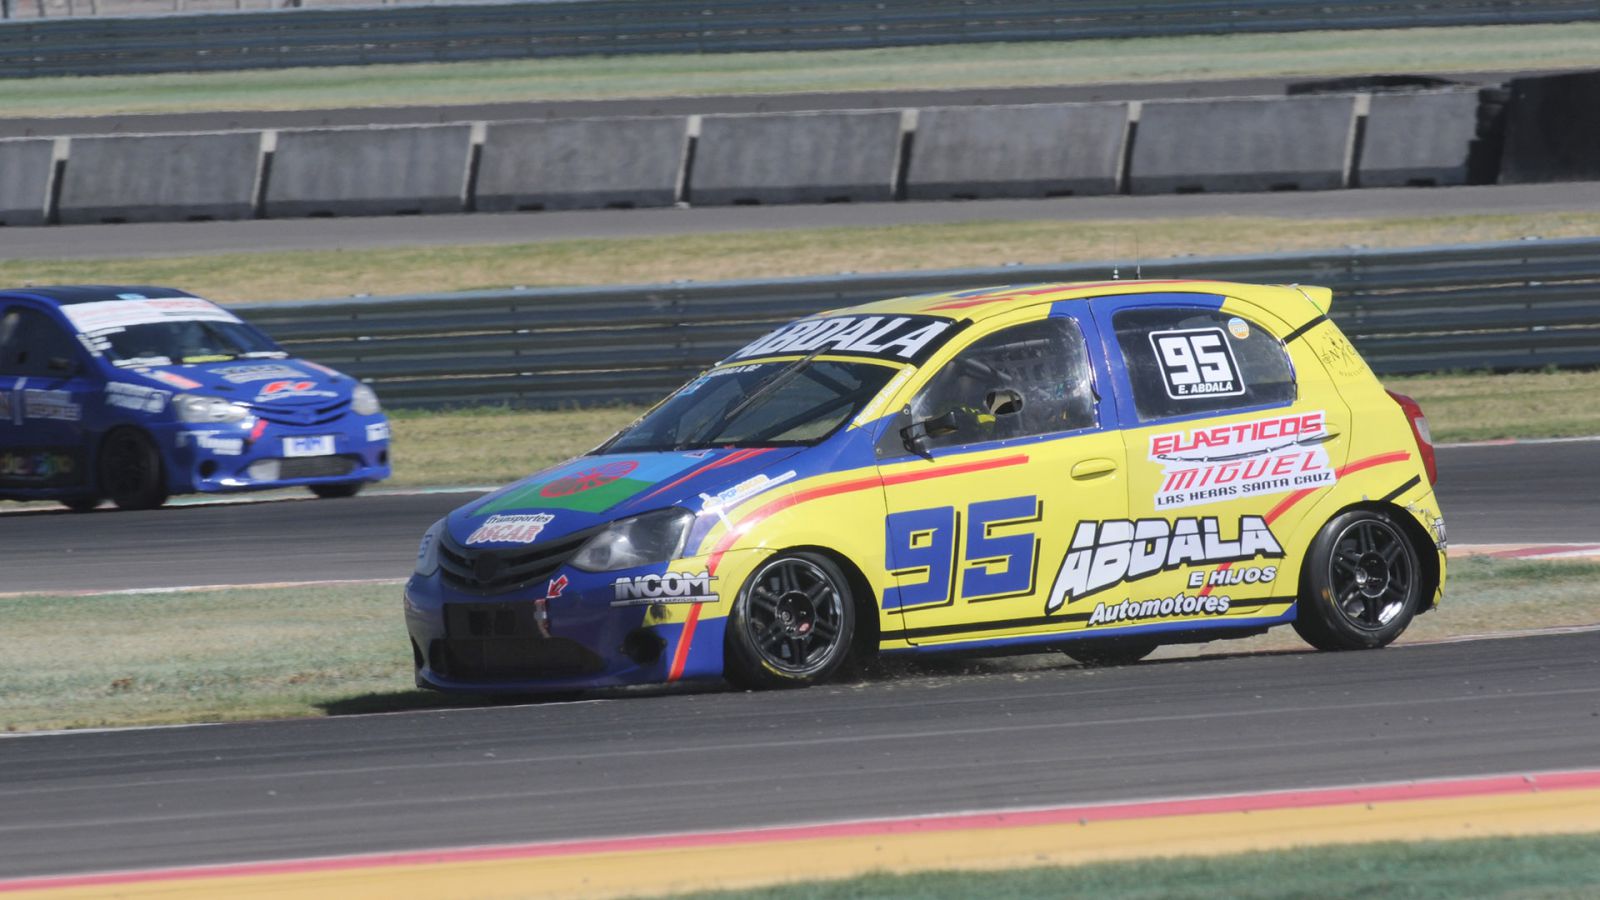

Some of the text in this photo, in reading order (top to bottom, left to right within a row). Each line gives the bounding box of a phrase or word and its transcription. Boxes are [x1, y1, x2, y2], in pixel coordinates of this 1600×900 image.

[737, 316, 949, 358] ABDALA
[1158, 335, 1233, 385] 95
[1178, 381, 1233, 394] E. ABDALA
[1152, 414, 1321, 455] ELASTICOS
[1163, 451, 1322, 492] MIGUEL
[1157, 472, 1332, 506] LAS HERAS SANTA CRUZ
[468, 524, 541, 543] OSCAR
[486, 513, 550, 525] Transportes
[881, 495, 1041, 612] 95
[1046, 515, 1285, 611] ABDALA
[615, 571, 709, 600] INCOM
[1188, 565, 1277, 587] E HIJOS
[1088, 592, 1231, 625] Automotores
